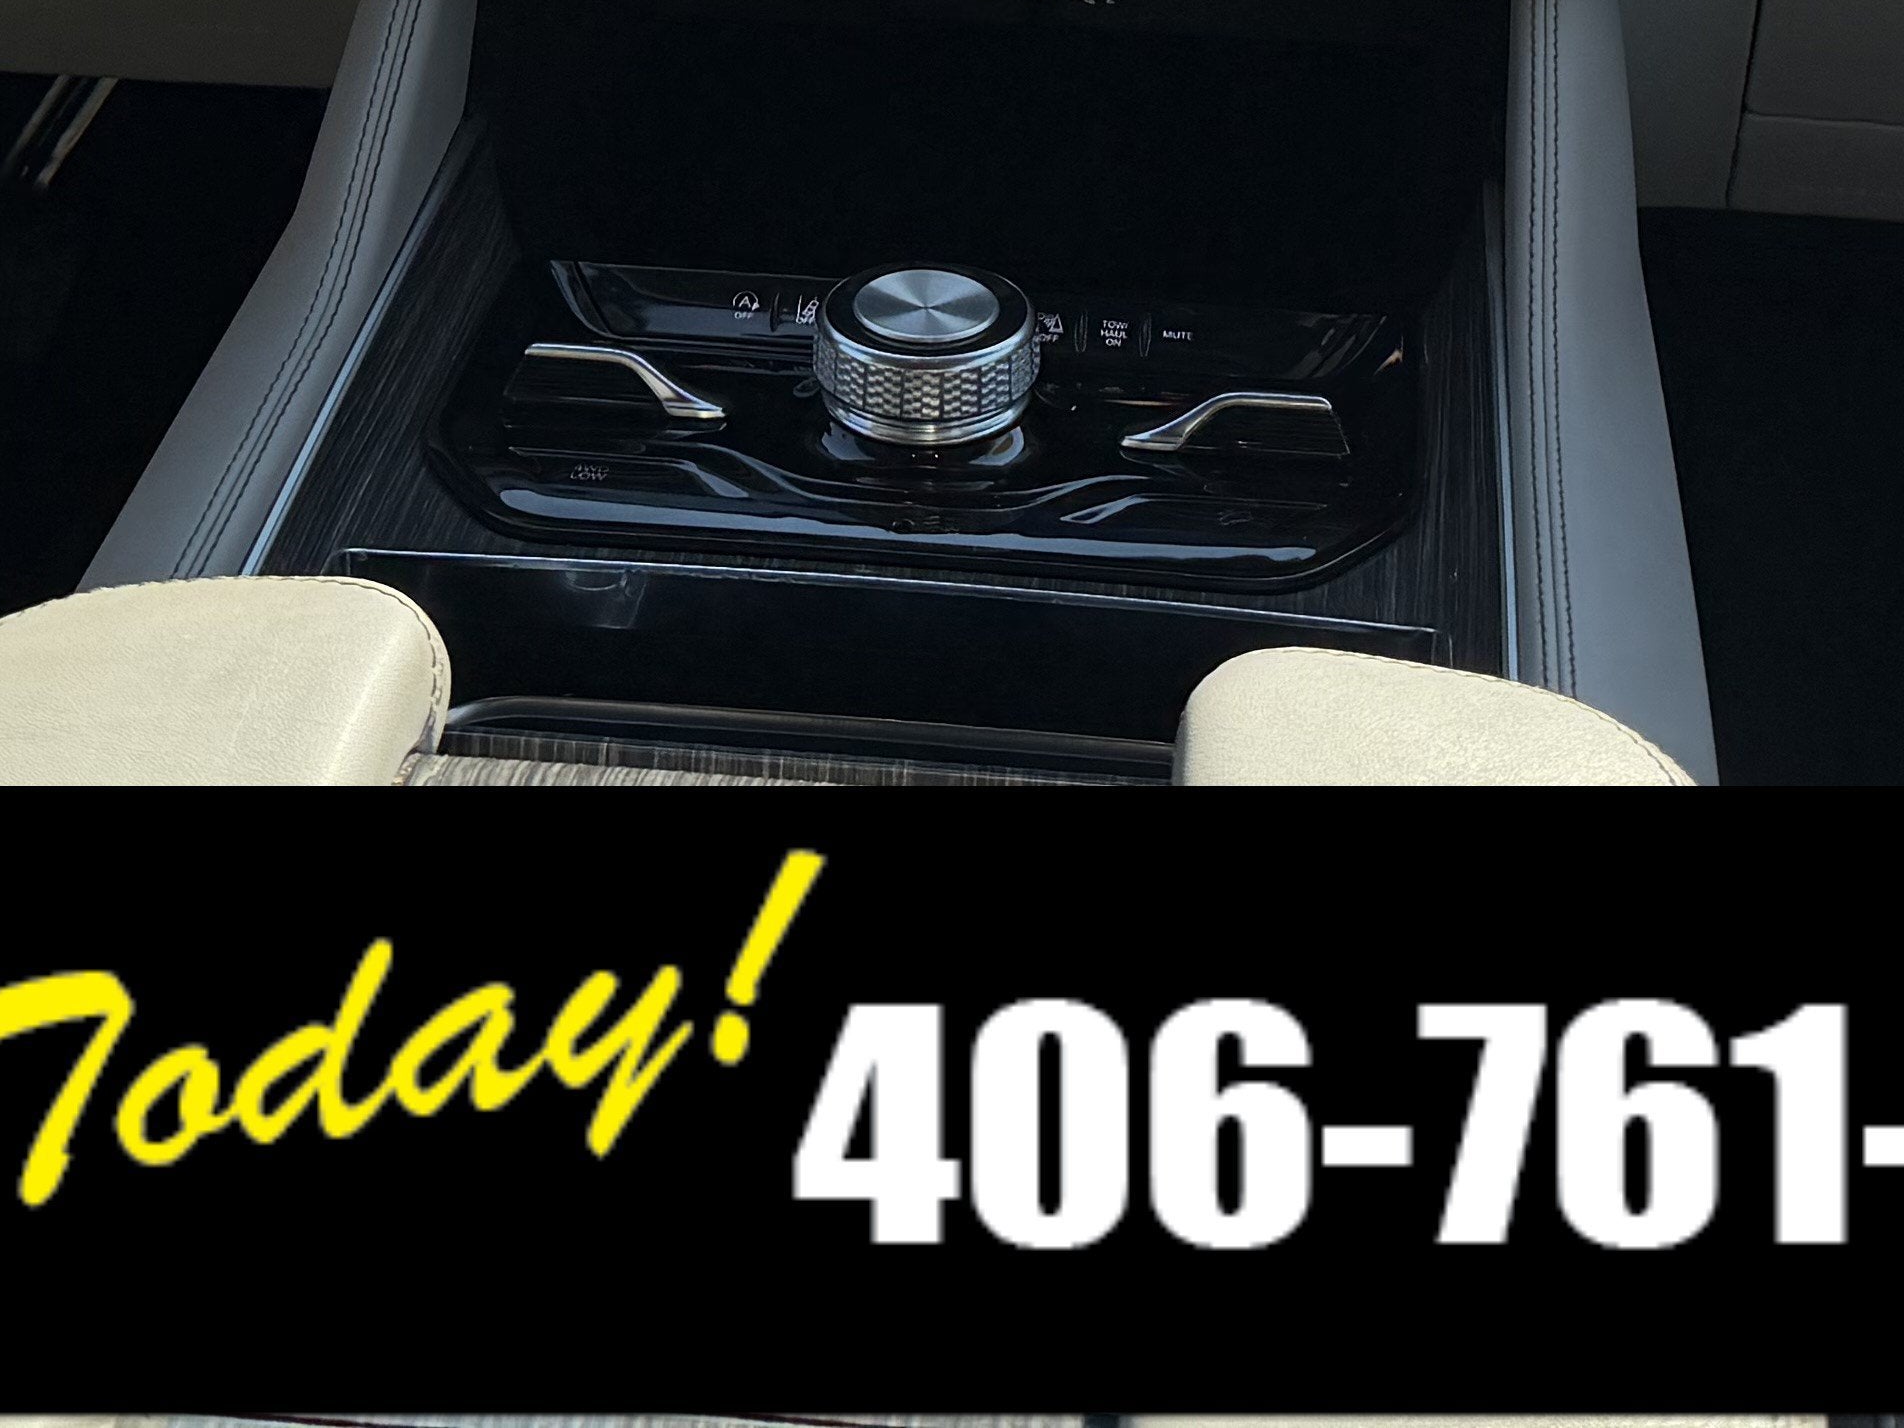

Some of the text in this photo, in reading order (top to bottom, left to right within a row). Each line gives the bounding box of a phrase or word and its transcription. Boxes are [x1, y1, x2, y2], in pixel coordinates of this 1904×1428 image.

[1100, 329, 1128, 339] HAUL
[1162, 330, 1194, 341] MUTE
[1105, 338, 1122, 347] ON
